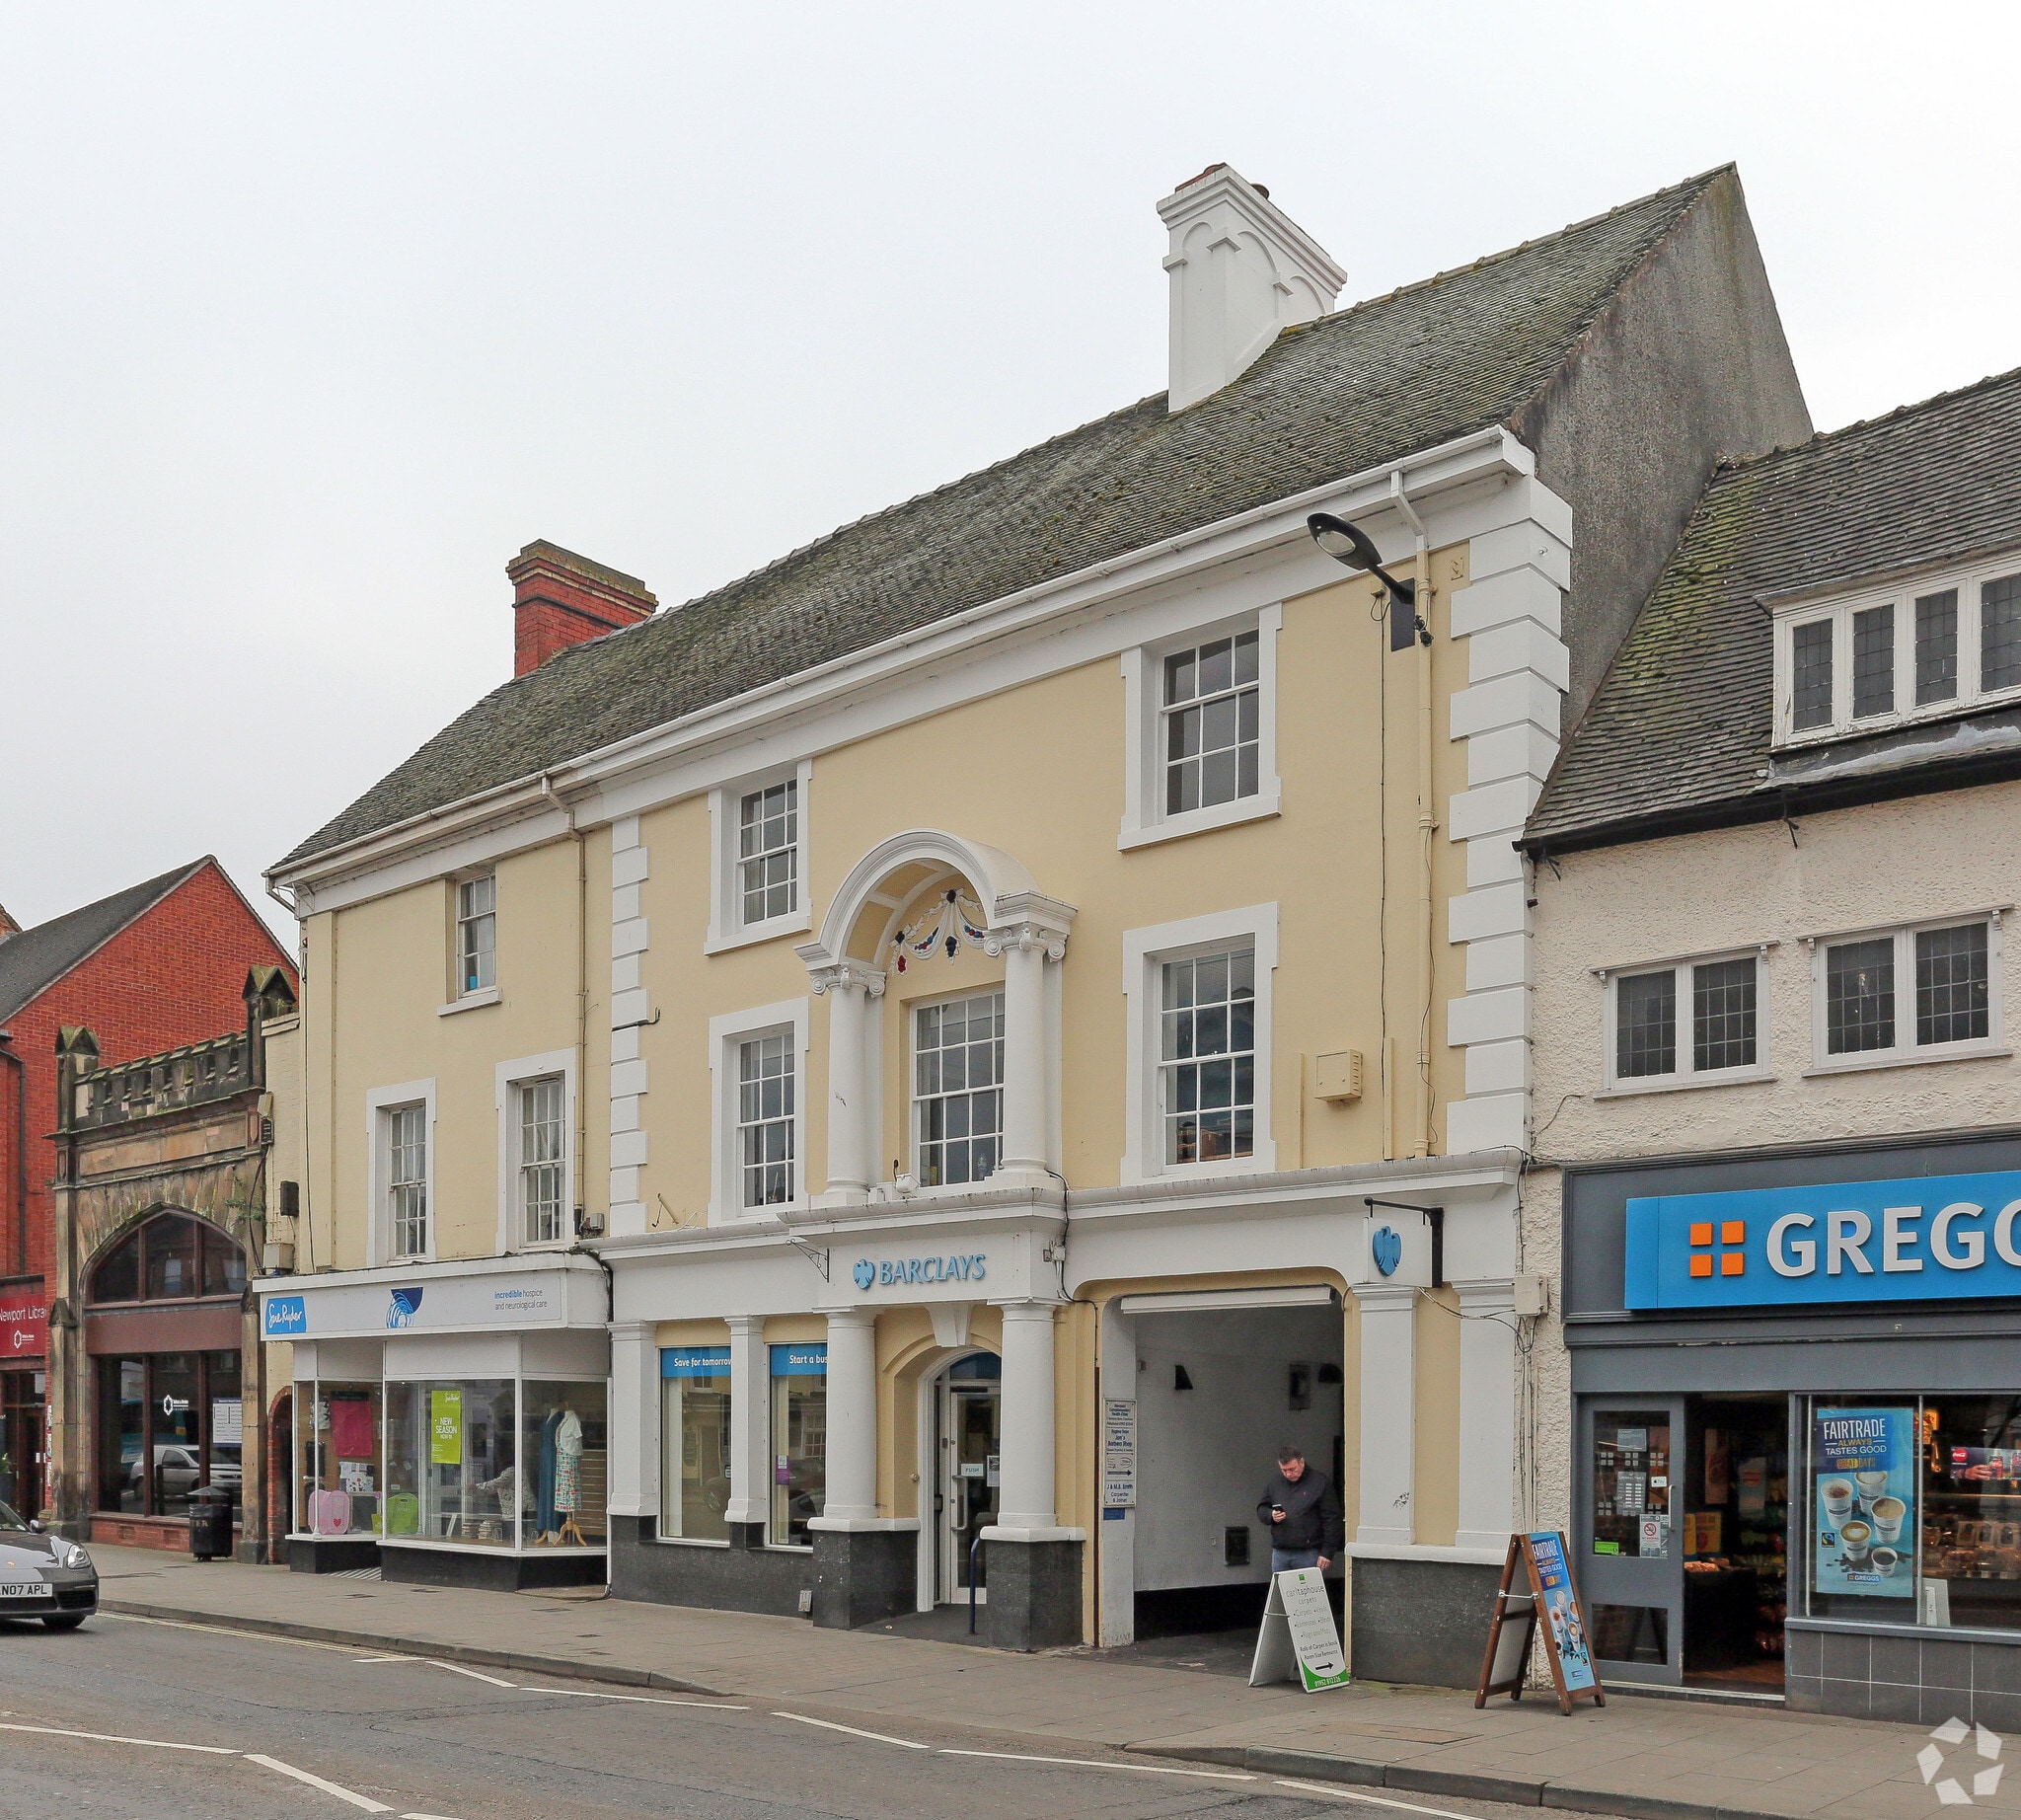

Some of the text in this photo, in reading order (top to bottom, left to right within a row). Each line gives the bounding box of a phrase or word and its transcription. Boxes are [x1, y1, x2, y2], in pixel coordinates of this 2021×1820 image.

[878, 1254, 986, 1285] BARCLAYS
[494, 1288, 544, 1299] incredible hospice
[505, 1300, 535, 1310] neurological
[536, 1300, 548, 1309] care
[28, 1305, 47, 1321] Libra
[674, 1357, 690, 1367] Save
[691, 1357, 701, 1368] for
[788, 1354, 807, 1365] Start
[435, 1425, 458, 1434] SEASON
[1823, 1418, 1887, 1440] FAIRTRADE
[1837, 1438, 1873, 1447] ALWAYS
[1825, 1445, 1888, 1456] TASTES GOOD
[0, 1584, 47, 1596] N07 APL
